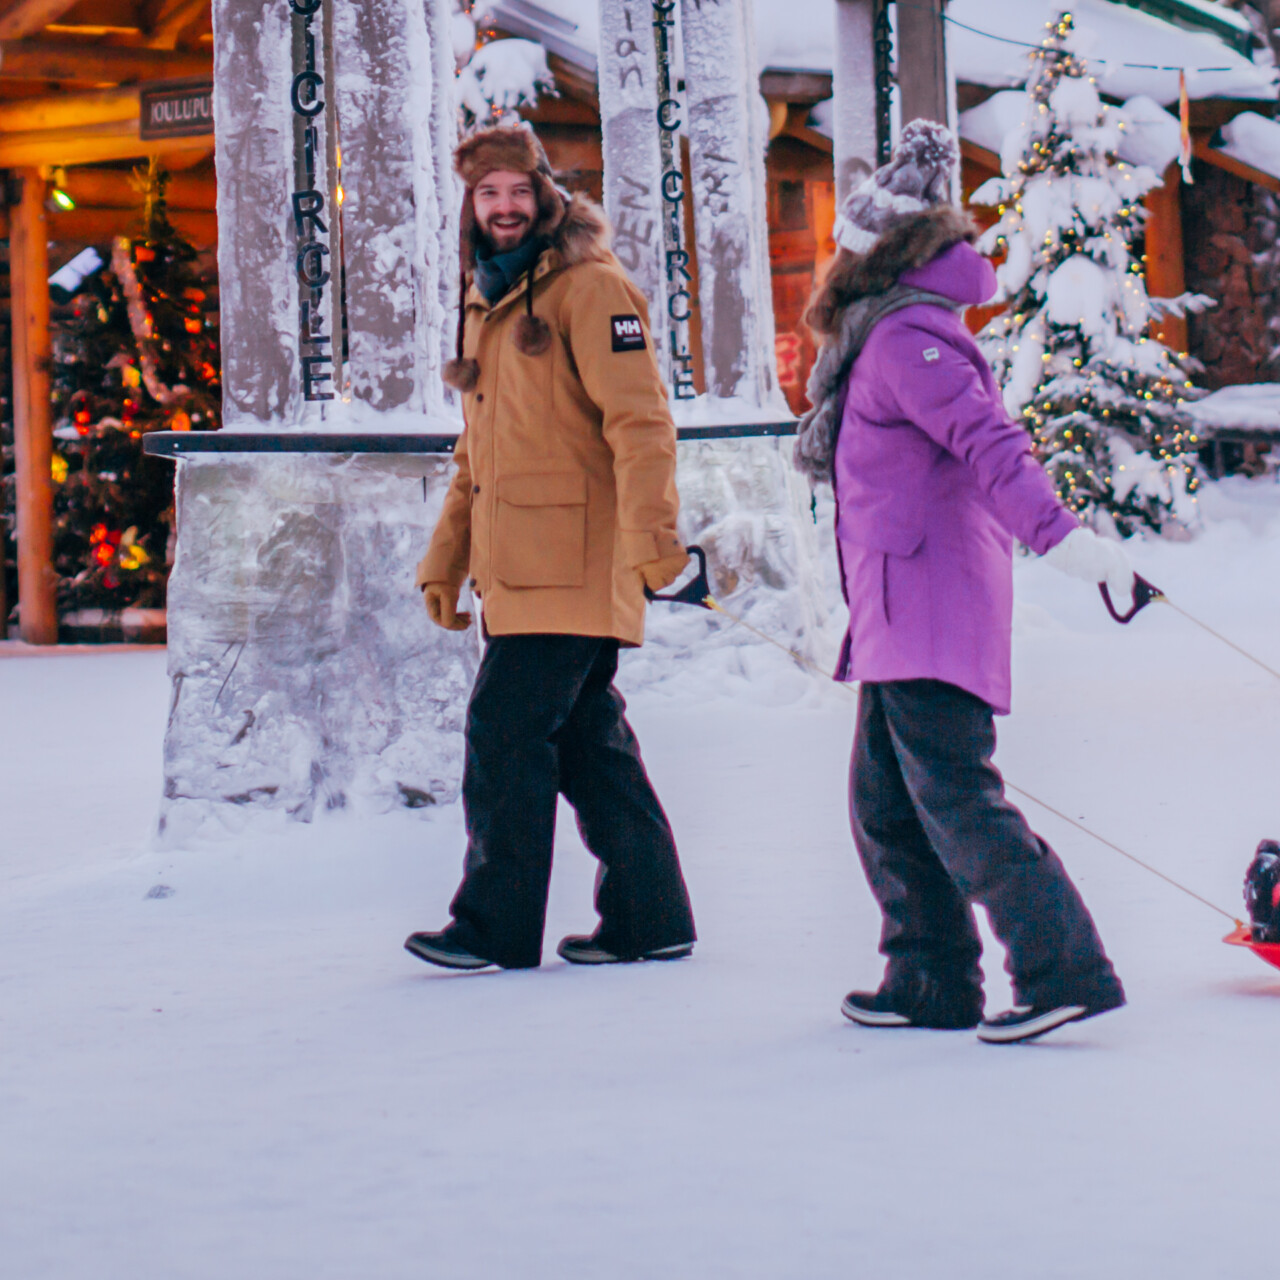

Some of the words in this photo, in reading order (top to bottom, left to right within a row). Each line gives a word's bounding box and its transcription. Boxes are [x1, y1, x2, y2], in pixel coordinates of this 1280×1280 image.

[150, 96, 215, 125] JOULUPU
[291, 70, 335, 401] CIRCLE
[661, 169, 696, 401] CIRCLE
[614, 320, 641, 335] HH
